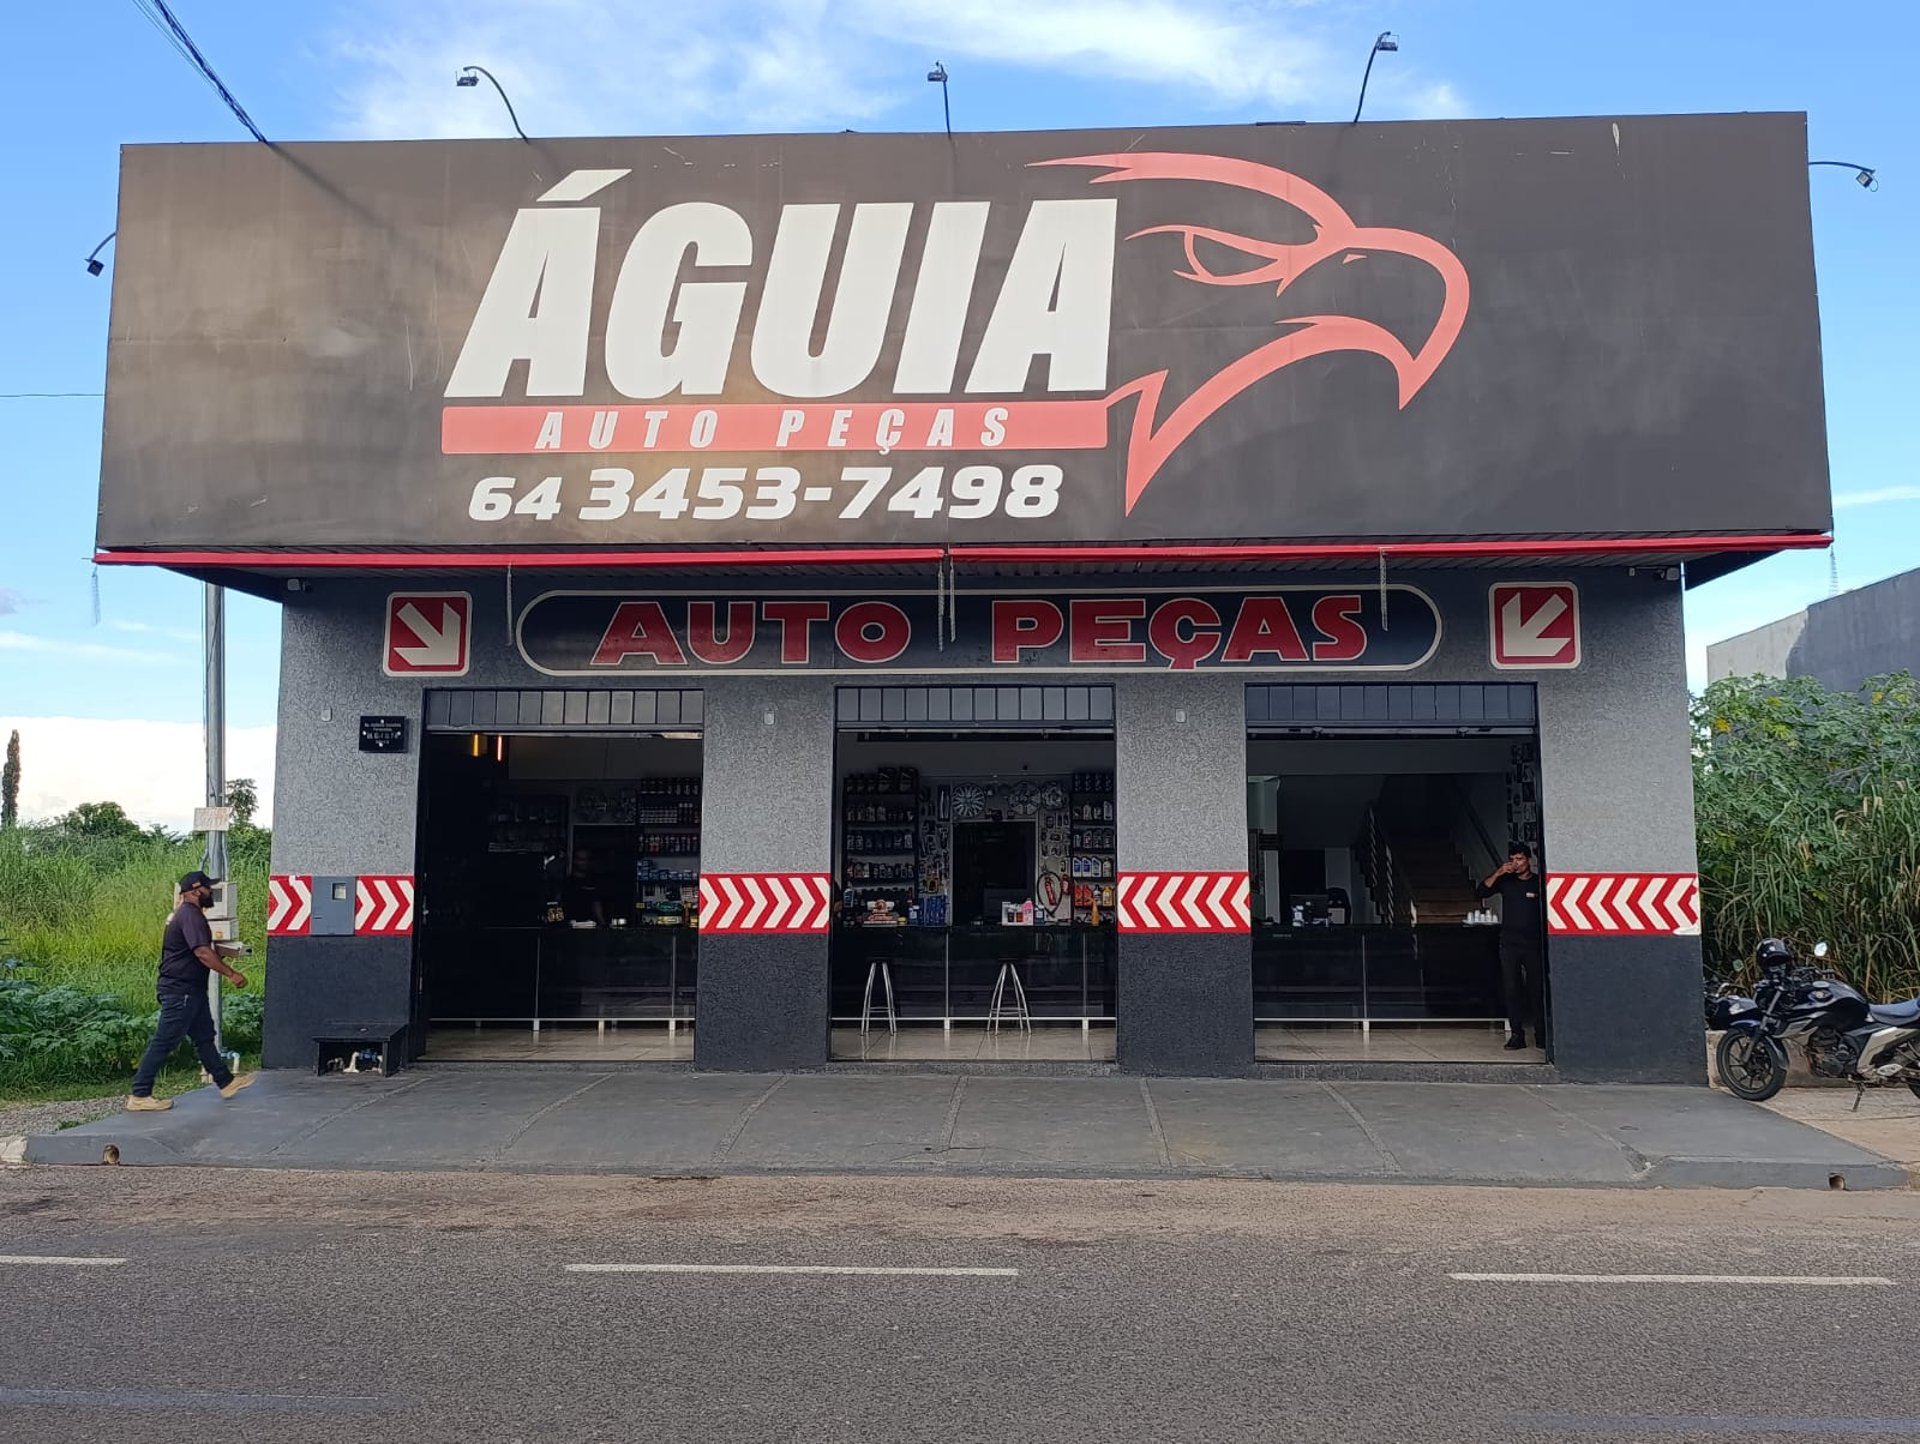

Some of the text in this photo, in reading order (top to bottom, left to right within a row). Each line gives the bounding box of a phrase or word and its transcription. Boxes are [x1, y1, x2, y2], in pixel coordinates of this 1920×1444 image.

[444, 169, 1117, 399] ÁGUIA
[534, 407, 1009, 455] AUTO PEÇAS
[468, 464, 1064, 520] 64 3453-7498
[590, 595, 1367, 670] AUTO PEÇAS
